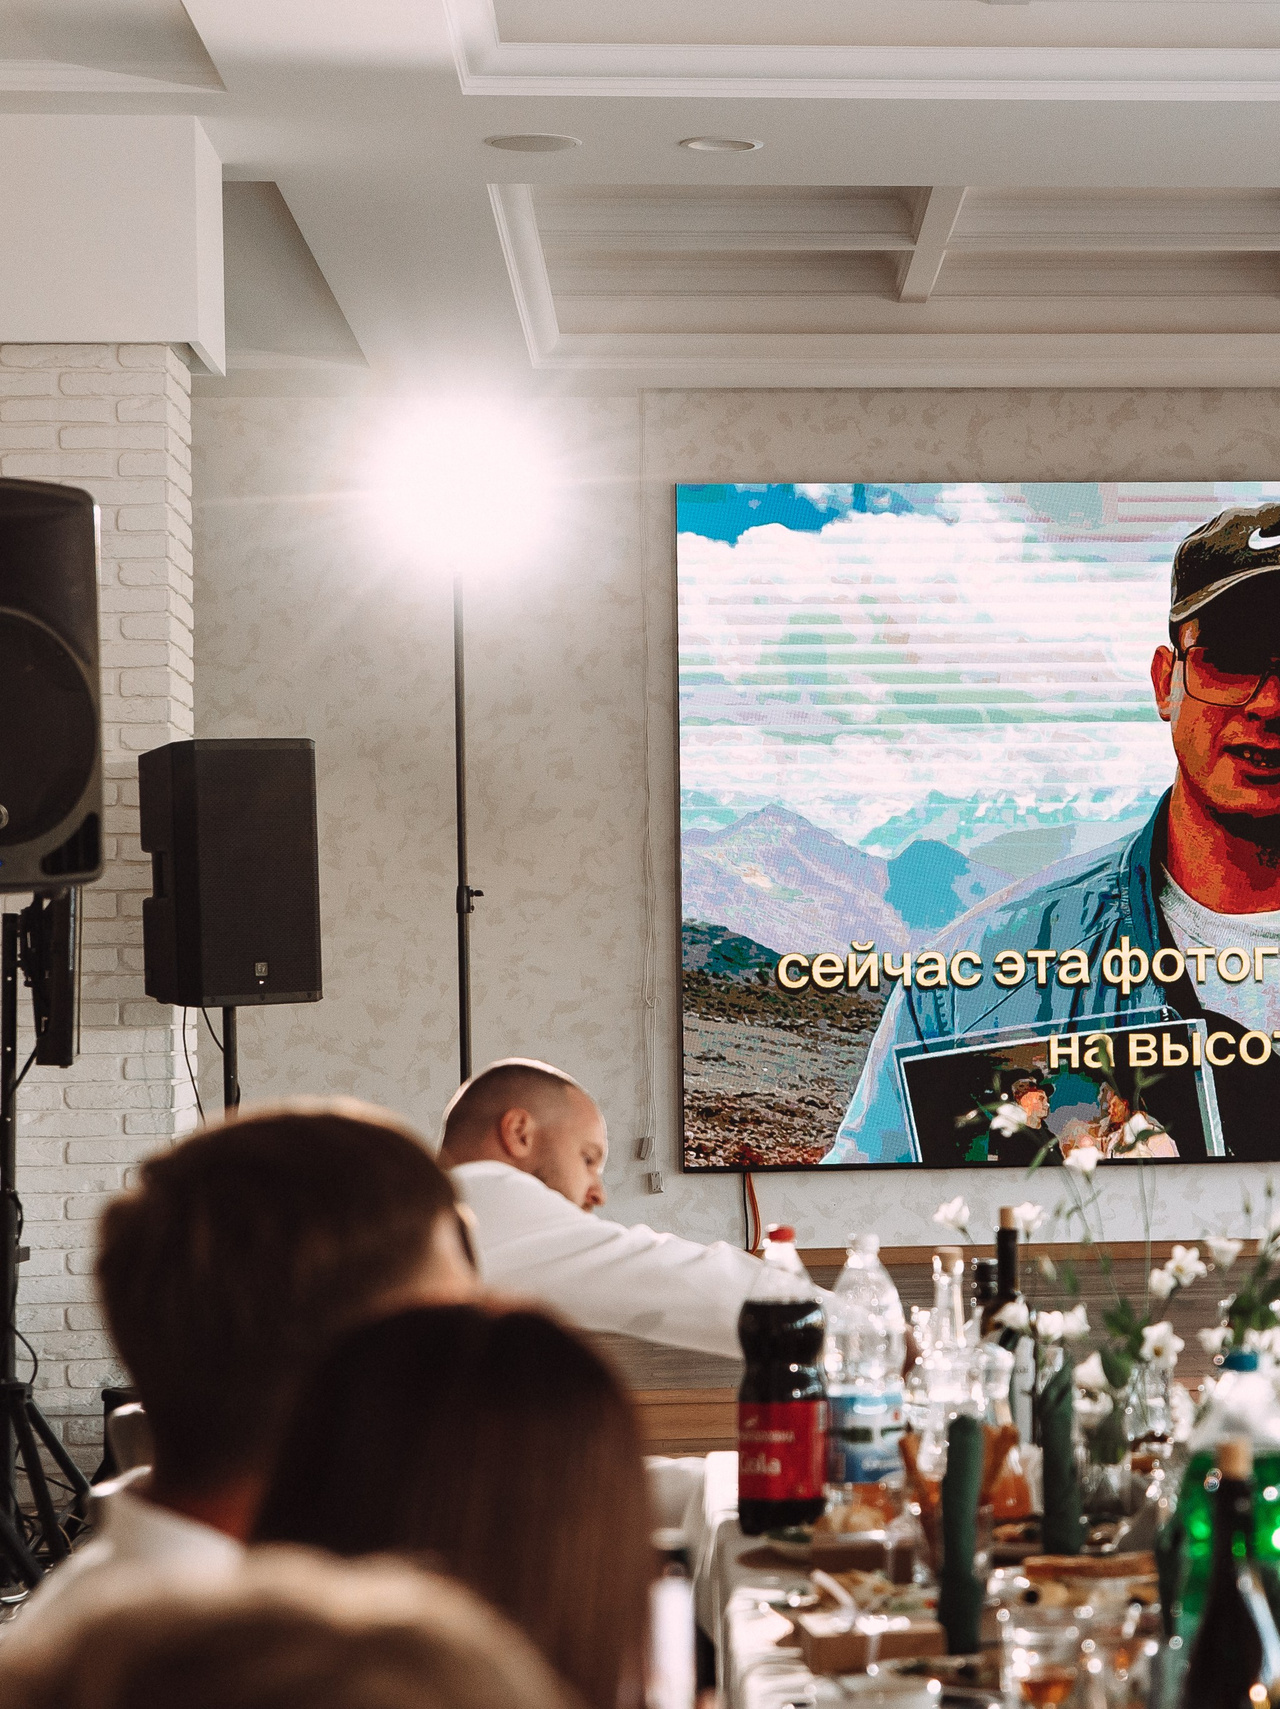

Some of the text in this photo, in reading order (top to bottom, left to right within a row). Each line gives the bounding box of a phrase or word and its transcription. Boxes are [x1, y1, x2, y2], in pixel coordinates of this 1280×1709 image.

[777, 941, 982, 989] сейчас
[994, 949, 1090, 986] эта
[1049, 1033, 1115, 1069] на
